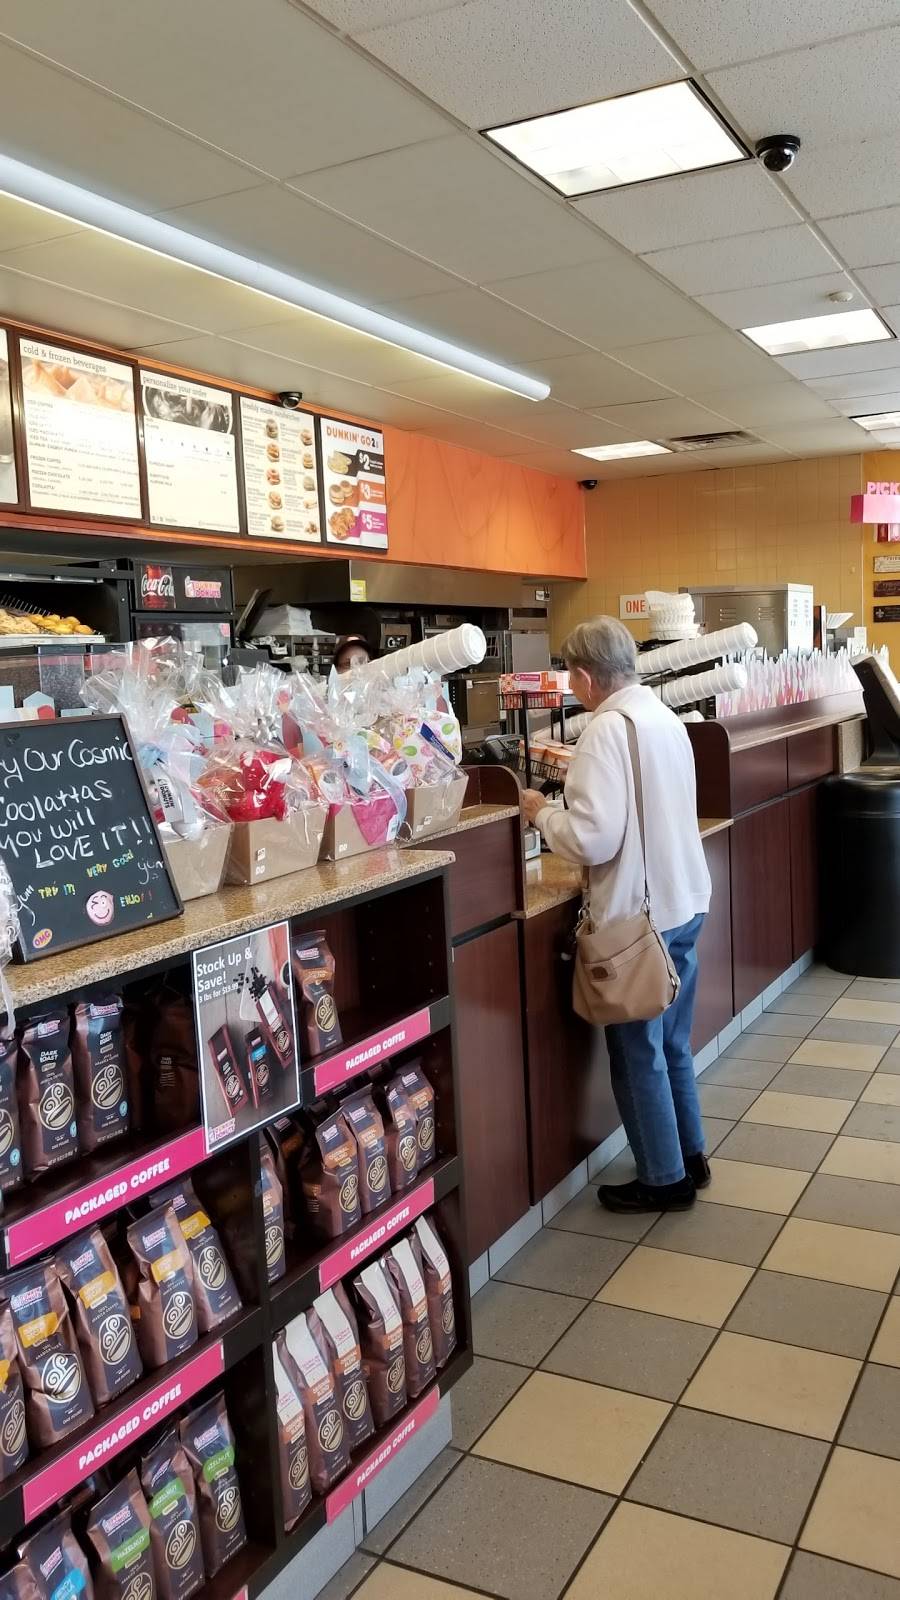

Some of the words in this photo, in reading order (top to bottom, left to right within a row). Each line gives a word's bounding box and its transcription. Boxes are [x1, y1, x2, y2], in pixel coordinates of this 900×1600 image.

[23, 344, 39, 356] cold
[48, 350, 72, 364] frozen
[73, 357, 107, 374] beverages
[326, 426, 360, 443] DUNKIN'
[358, 452, 371, 470] $2
[361, 512, 373, 530] $5
[626, 600, 646, 613] ONE
[23, 747, 64, 772] Our
[68, 738, 132, 768] Cosmic
[50, 807, 96, 840] will
[35, 834, 94, 868] LOVE
[86, 863, 108, 878] VERY
[34, 931, 51, 949] OMG
[197, 956, 227, 978] Stock
[227, 952, 243, 970] Up
[244, 946, 253, 961] &
[197, 971, 227, 993] Save!
[204, 992, 213, 1002] lbs
[212, 990, 222, 1000] for
[99, 1031, 112, 1039] DARK
[40, 1050, 58, 1059] DARK
[345, 1042, 382, 1071] PACKAGED
[382, 1030, 406, 1051] COFFEE
[64, 1181, 128, 1225] PACKAGED
[130, 1158, 171, 1189] COFFEE
[350, 1227, 388, 1261] PACKAGED
[387, 1206, 410, 1230] COFFEE
[79, 1415, 141, 1471] PACKAGED
[142, 1384, 182, 1422] COFFEE
[356, 1446, 393, 1488] PACKAGED
[392, 1418, 416, 1450] COFFEE
[116, 1536, 146, 1562] HAZELNUT
